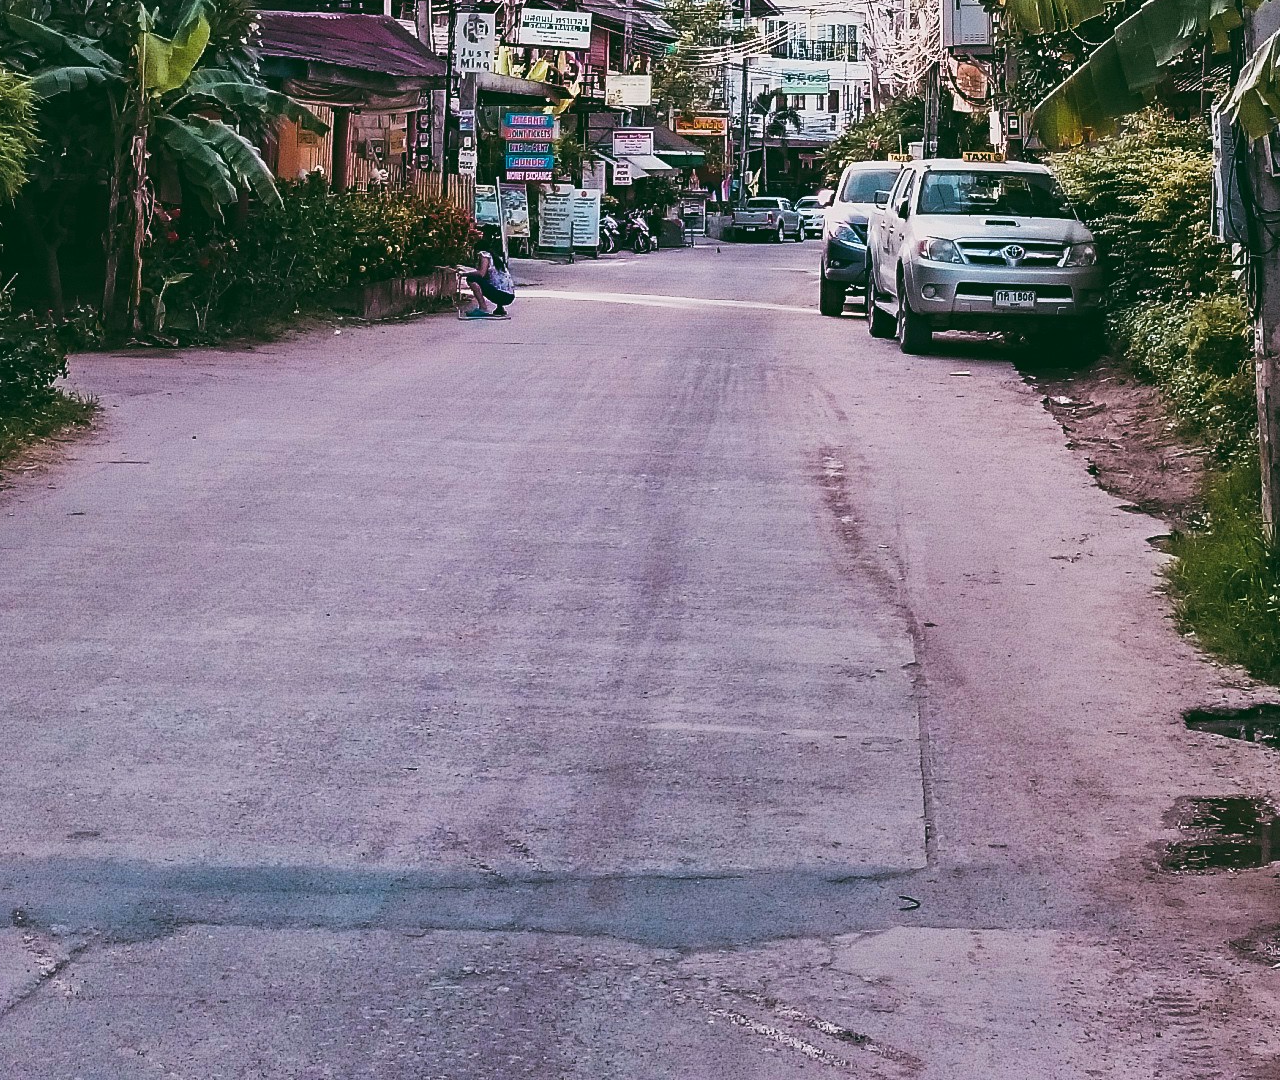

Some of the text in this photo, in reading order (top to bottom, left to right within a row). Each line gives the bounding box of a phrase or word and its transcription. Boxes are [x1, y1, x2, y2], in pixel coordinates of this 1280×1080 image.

[509, 114, 549, 125] INTERNET
[507, 128, 552, 138] JOINT TICKETS
[965, 152, 991, 161] TAXI
[508, 157, 550, 167] LAUNDRY
[506, 171, 553, 181] MONEY EXCHANGE
